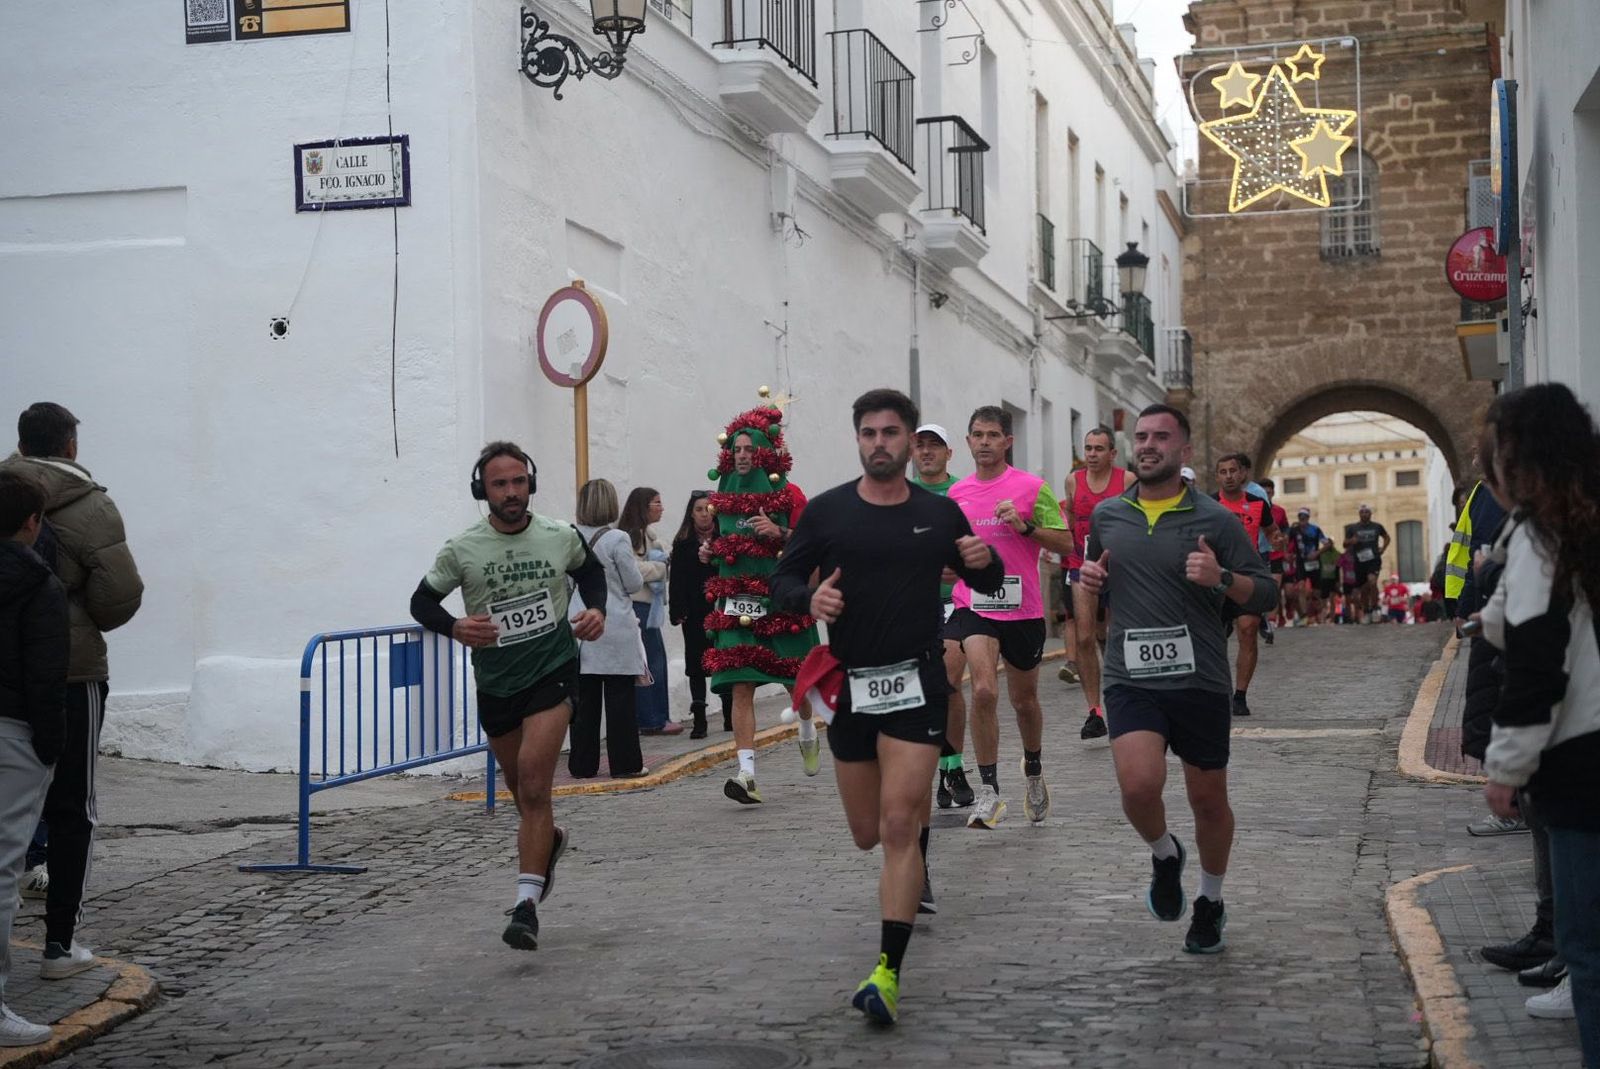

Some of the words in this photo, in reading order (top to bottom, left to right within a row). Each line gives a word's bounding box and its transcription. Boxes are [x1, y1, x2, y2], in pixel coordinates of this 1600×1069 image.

[336, 155, 368, 169] CALLE
[320, 176, 342, 190] FCO.
[345, 173, 386, 188] IGNACIO
[1453, 270, 1508, 283] Cruzcamp
[1303, 450, 1418, 466] CHICLANA
[483, 565, 496, 577] XI
[498, 560, 552, 573] CARRERA
[502, 569, 556, 583] POPULAR
[733, 601, 762, 614] 1934
[500, 604, 547, 630] 1925
[1139, 642, 1178, 662] 803
[868, 676, 905, 698] 806
